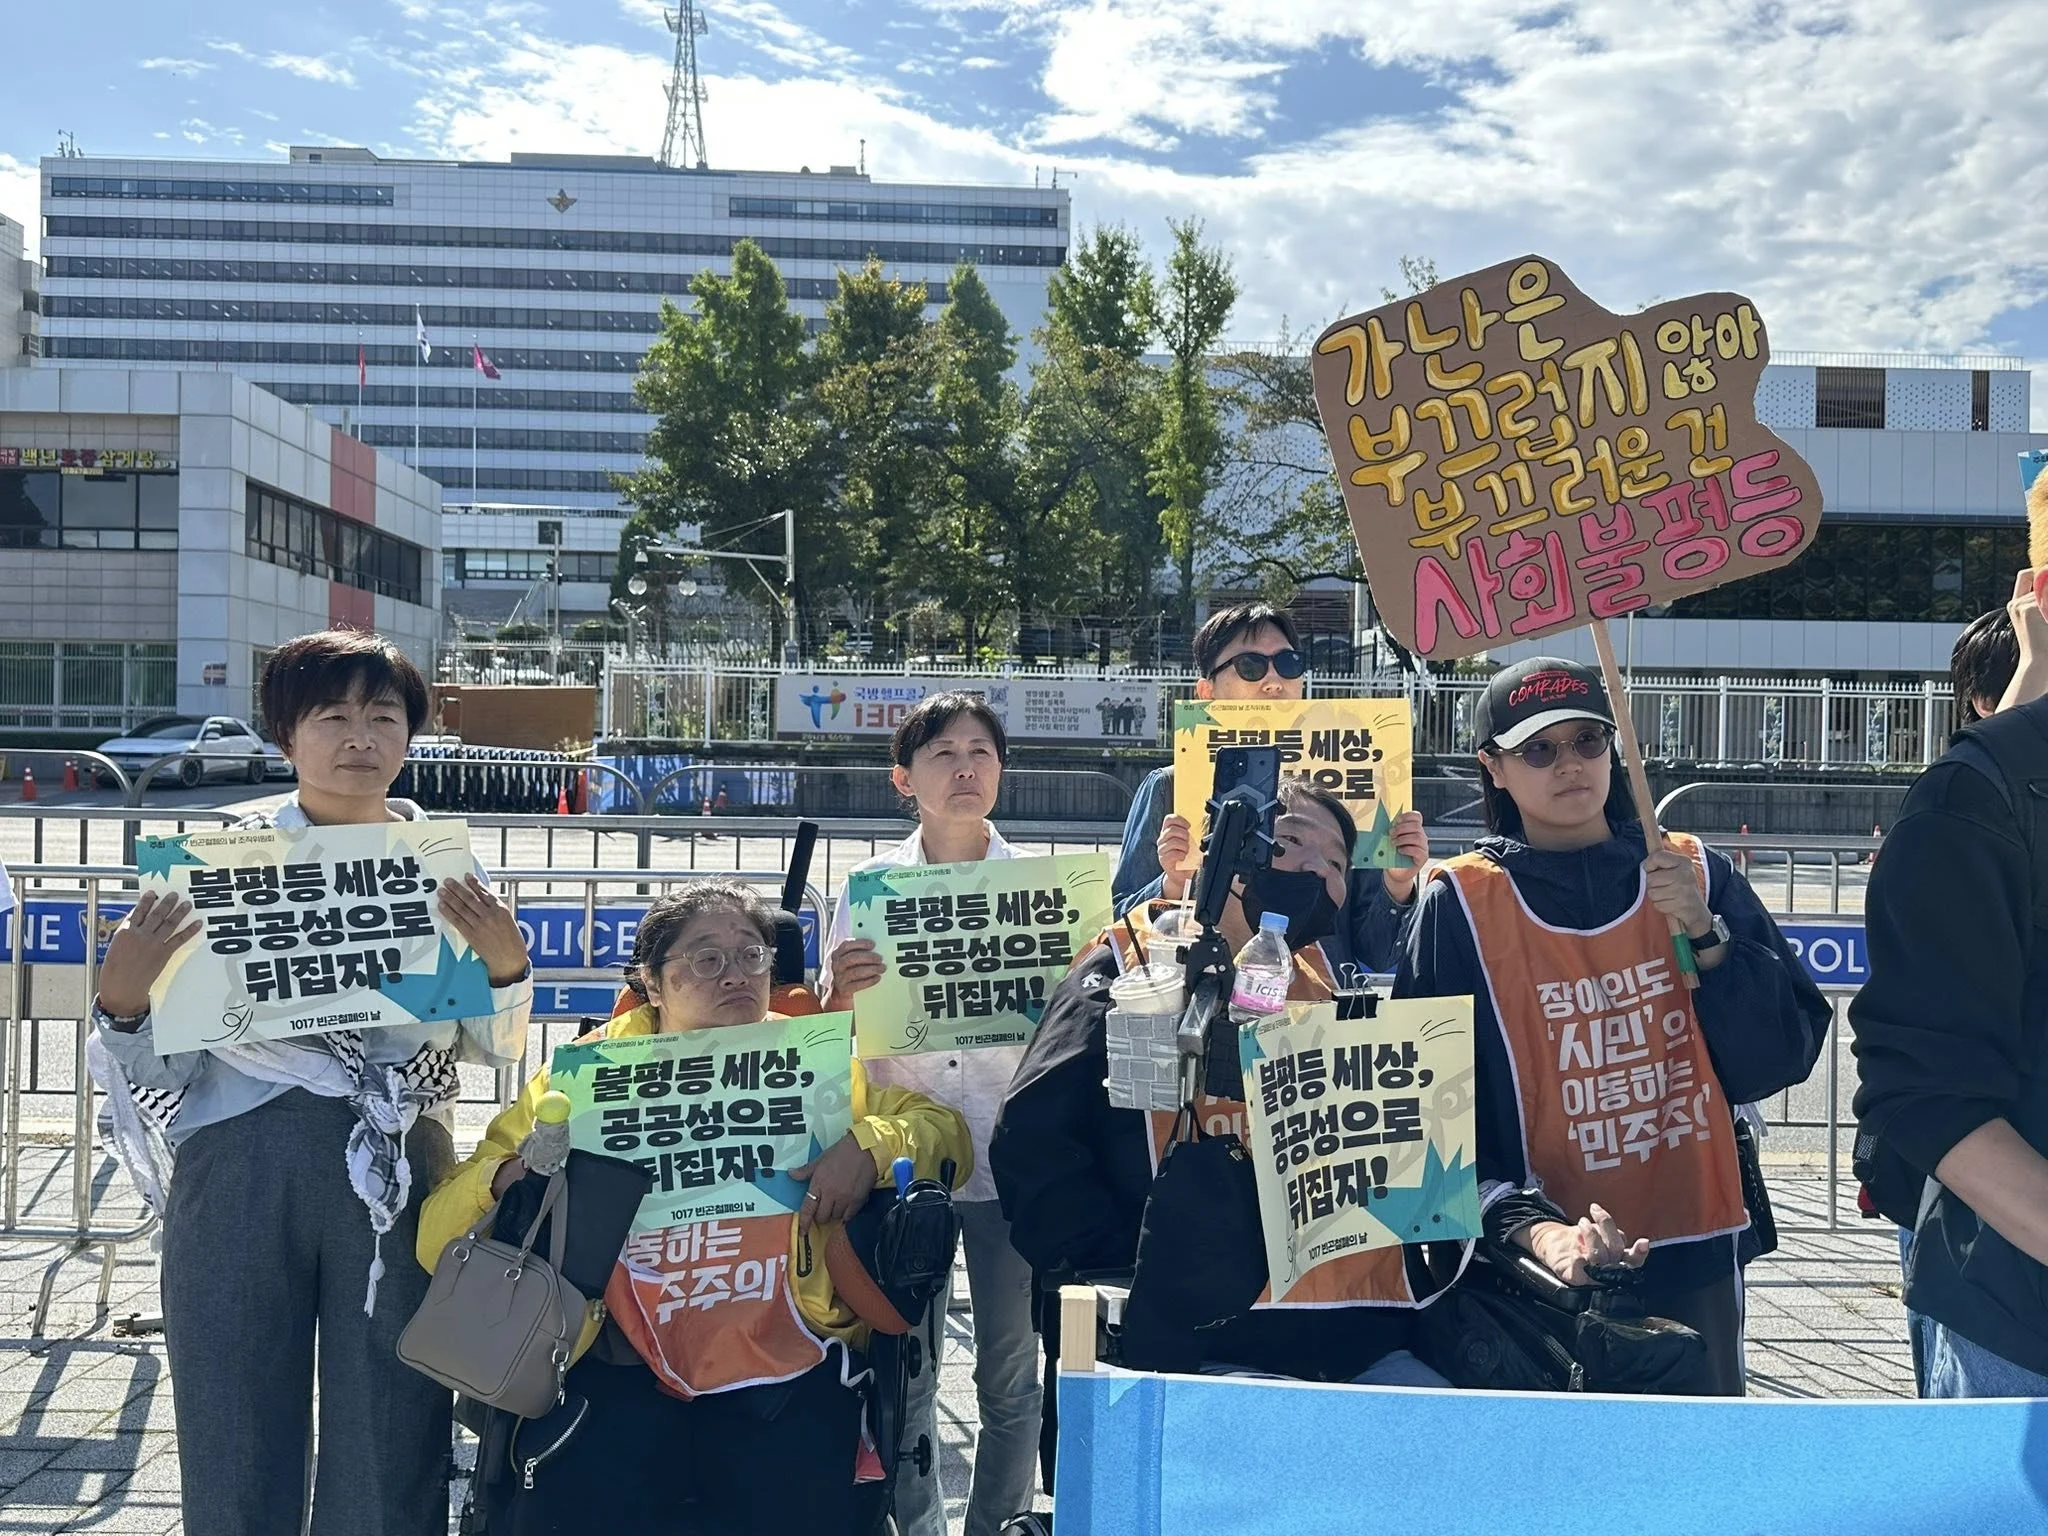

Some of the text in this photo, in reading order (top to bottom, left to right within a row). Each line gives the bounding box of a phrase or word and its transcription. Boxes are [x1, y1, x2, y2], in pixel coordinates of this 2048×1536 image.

[1318, 260, 1566, 406] 가난은
[1349, 304, 1761, 506] 부끄럽지 않아
[1408, 403, 1734, 560] 부끄러운 건
[854, 703, 908, 728] 130
[1509, 678, 1588, 707] COMRADES
[1308, 729, 1383, 763] 세상,
[188, 856, 438, 909] 불평등 세상,
[6, 914, 60, 950] NE
[206, 901, 436, 955] 공공성으로
[884, 887, 1080, 936] 불평등 세상,
[518, 920, 638, 956] OLICE
[896, 931, 1074, 978] 공공성으로
[1785, 937, 1864, 973] POL
[245, 947, 402, 1002] 뒤집자!
[923, 976, 1045, 1020] 뒤집자!
[1255, 983, 1279, 997] ICIS
[1537, 957, 1675, 1019] 장애인도
[289, 1009, 382, 1032] 1017 빈곤철폐의 날
[955, 1032, 1026, 1045] 1017 빈곤철폐의 날
[592, 1048, 814, 1102] 불평등 세상,
[1260, 1041, 1434, 1116] 불평등 세상,
[1561, 1057, 1694, 1116] 이동하는
[600, 1095, 806, 1151] 공공성으로
[1270, 1097, 1423, 1175] 공공성으로
[644, 1144, 775, 1194] 뒤집자!
[670, 1202, 755, 1221] 1017 빈곤철폐의 날
[1287, 1156, 1388, 1232] 뒤집자!
[627, 1221, 743, 1269] 동하는
[1308, 1247, 1321, 1261] 1017
[1358, 1231, 1368, 1246] 날
[656, 1254, 789, 1325] 주주의'
